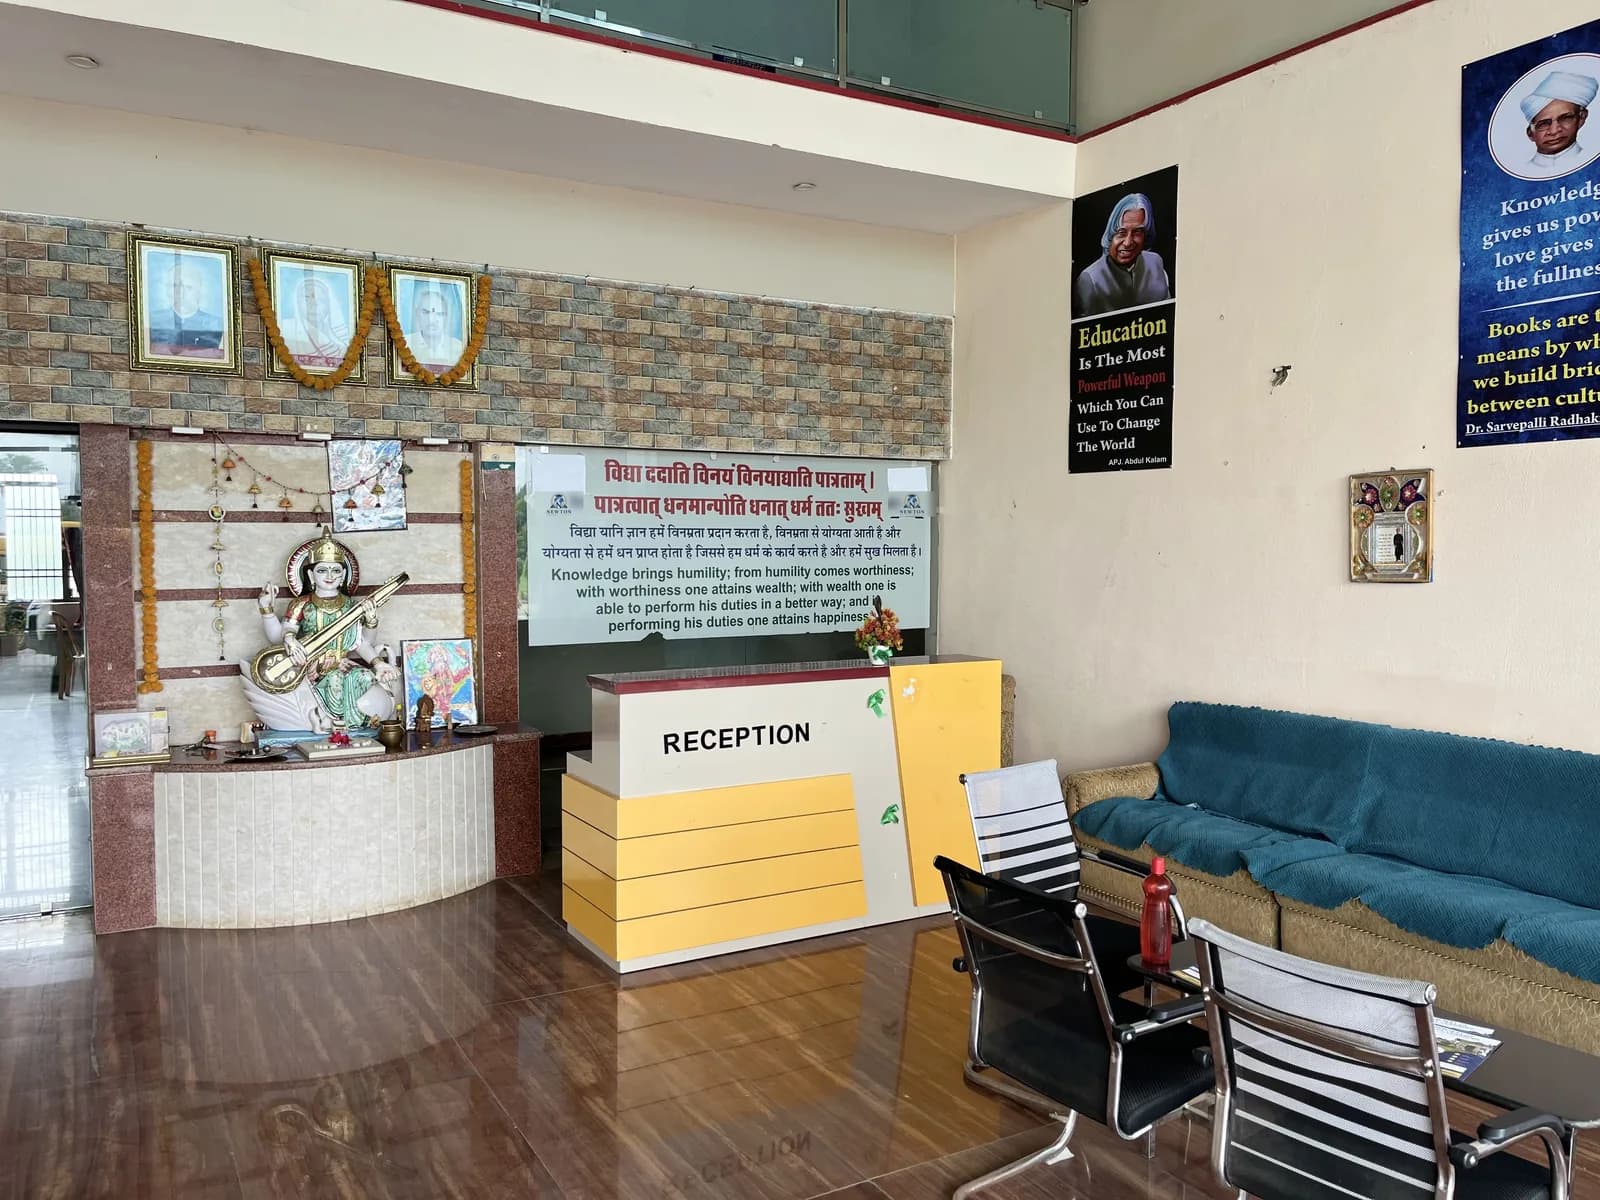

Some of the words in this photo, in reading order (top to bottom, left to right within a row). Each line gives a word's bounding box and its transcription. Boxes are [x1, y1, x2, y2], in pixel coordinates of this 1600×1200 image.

[1482, 225, 1532, 250] gives
[1536, 218, 1560, 233] us
[1495, 250, 1536, 268] love
[1540, 238, 1594, 264] gives
[1496, 275, 1528, 292] the
[1078, 317, 1168, 349] Education
[1487, 316, 1552, 339] Books
[1556, 313, 1590, 328] are
[1078, 357, 1092, 371] Is
[1094, 353, 1124, 368] The
[1126, 345, 1166, 363] Most
[1476, 346, 1540, 365] means
[1545, 339, 1571, 359] by
[1078, 373, 1121, 394] Powerful
[1123, 371, 1166, 389] Weapon
[1472, 376, 1500, 390] we
[1504, 364, 1558, 386] build
[1077, 401, 1113, 415] Which
[1115, 398, 1138, 411] You
[1140, 395, 1164, 407] Can
[1466, 395, 1551, 415] between
[1077, 422, 1097, 434] Use
[1099, 420, 1114, 432] To
[1116, 416, 1161, 430] Change
[1465, 424, 1484, 434] Dr.
[1486, 417, 1547, 432] Sarvepalli
[1076, 441, 1098, 453] The
[1100, 437, 1136, 450] World
[1124, 457, 1145, 465] Abdul
[1145, 456, 1167, 464] Kalam
[645, 461, 691, 484] ददाति
[693, 462, 736, 486] विनयं
[815, 472, 868, 493] पात्रताम्
[749, 498, 790, 521] धनात्
[790, 495, 814, 517] धर्म
[844, 500, 884, 522] सुखम्
[569, 523, 596, 538] विद्या
[626, 527, 647, 538] ज्ञान
[649, 523, 666, 539] हमें
[667, 524, 705, 538] विनम्रता
[707, 528, 732, 540] प्रदान
[734, 527, 760, 538] करता
[775, 525, 809, 539] विनम्रता
[811, 525, 820, 538] से
[821, 524, 851, 539] योग्यता
[853, 525, 874, 539] आती
[876, 524, 883, 540] है
[885, 525, 901, 539] और
[541, 544, 581, 559] योग्यता
[583, 544, 594, 559] से
[596, 544, 614, 560] हमें
[616, 547, 634, 559] धन
[635, 547, 658, 559] प्राप्त
[660, 544, 683, 560] होता
[685, 544, 693, 560] है
[695, 544, 726, 559] जिससे
[727, 547, 742, 559] हम
[744, 544, 760, 557] धर्म
[761, 544, 772, 558] के
[774, 543, 796, 557] कार्य
[797, 544, 819, 558] करते
[830, 543, 846, 557] और
[848, 543, 863, 559] हमें
[864, 547, 880, 560] सुख
[882, 543, 909, 557] मिलता
[551, 567, 628, 583] Knowledge
[632, 567, 673, 582] brings
[677, 566, 731, 581] humility;
[734, 566, 762, 578] from
[765, 565, 811, 579] humility
[814, 566, 850, 577] comes
[853, 565, 914, 577] worthiness;
[576, 585, 605, 598] with
[609, 584, 681, 597] worthiness
[685, 585, 708, 596] one
[711, 583, 751, 595] attains
[755, 581, 797, 594] wealth;
[800, 581, 823, 592] with
[826, 580, 862, 592] wealth
[864, 581, 884, 591] one
[887, 580, 896, 591] is
[596, 602, 624, 615] able
[628, 602, 641, 614] to
[645, 601, 695, 616] perform
[699, 599, 717, 612] his
[721, 598, 758, 611] duties
[761, 598, 772, 609] in
[775, 599, 782, 609] a
[785, 597, 817, 608] better
[820, 598, 846, 610] way;
[849, 595, 869, 607] and
[608, 618, 680, 634] performing
[684, 616, 703, 629] his
[706, 615, 744, 628] duties
[747, 616, 769, 626] one
[772, 613, 810, 625] attains
[663, 722, 810, 755] RECEPTION
